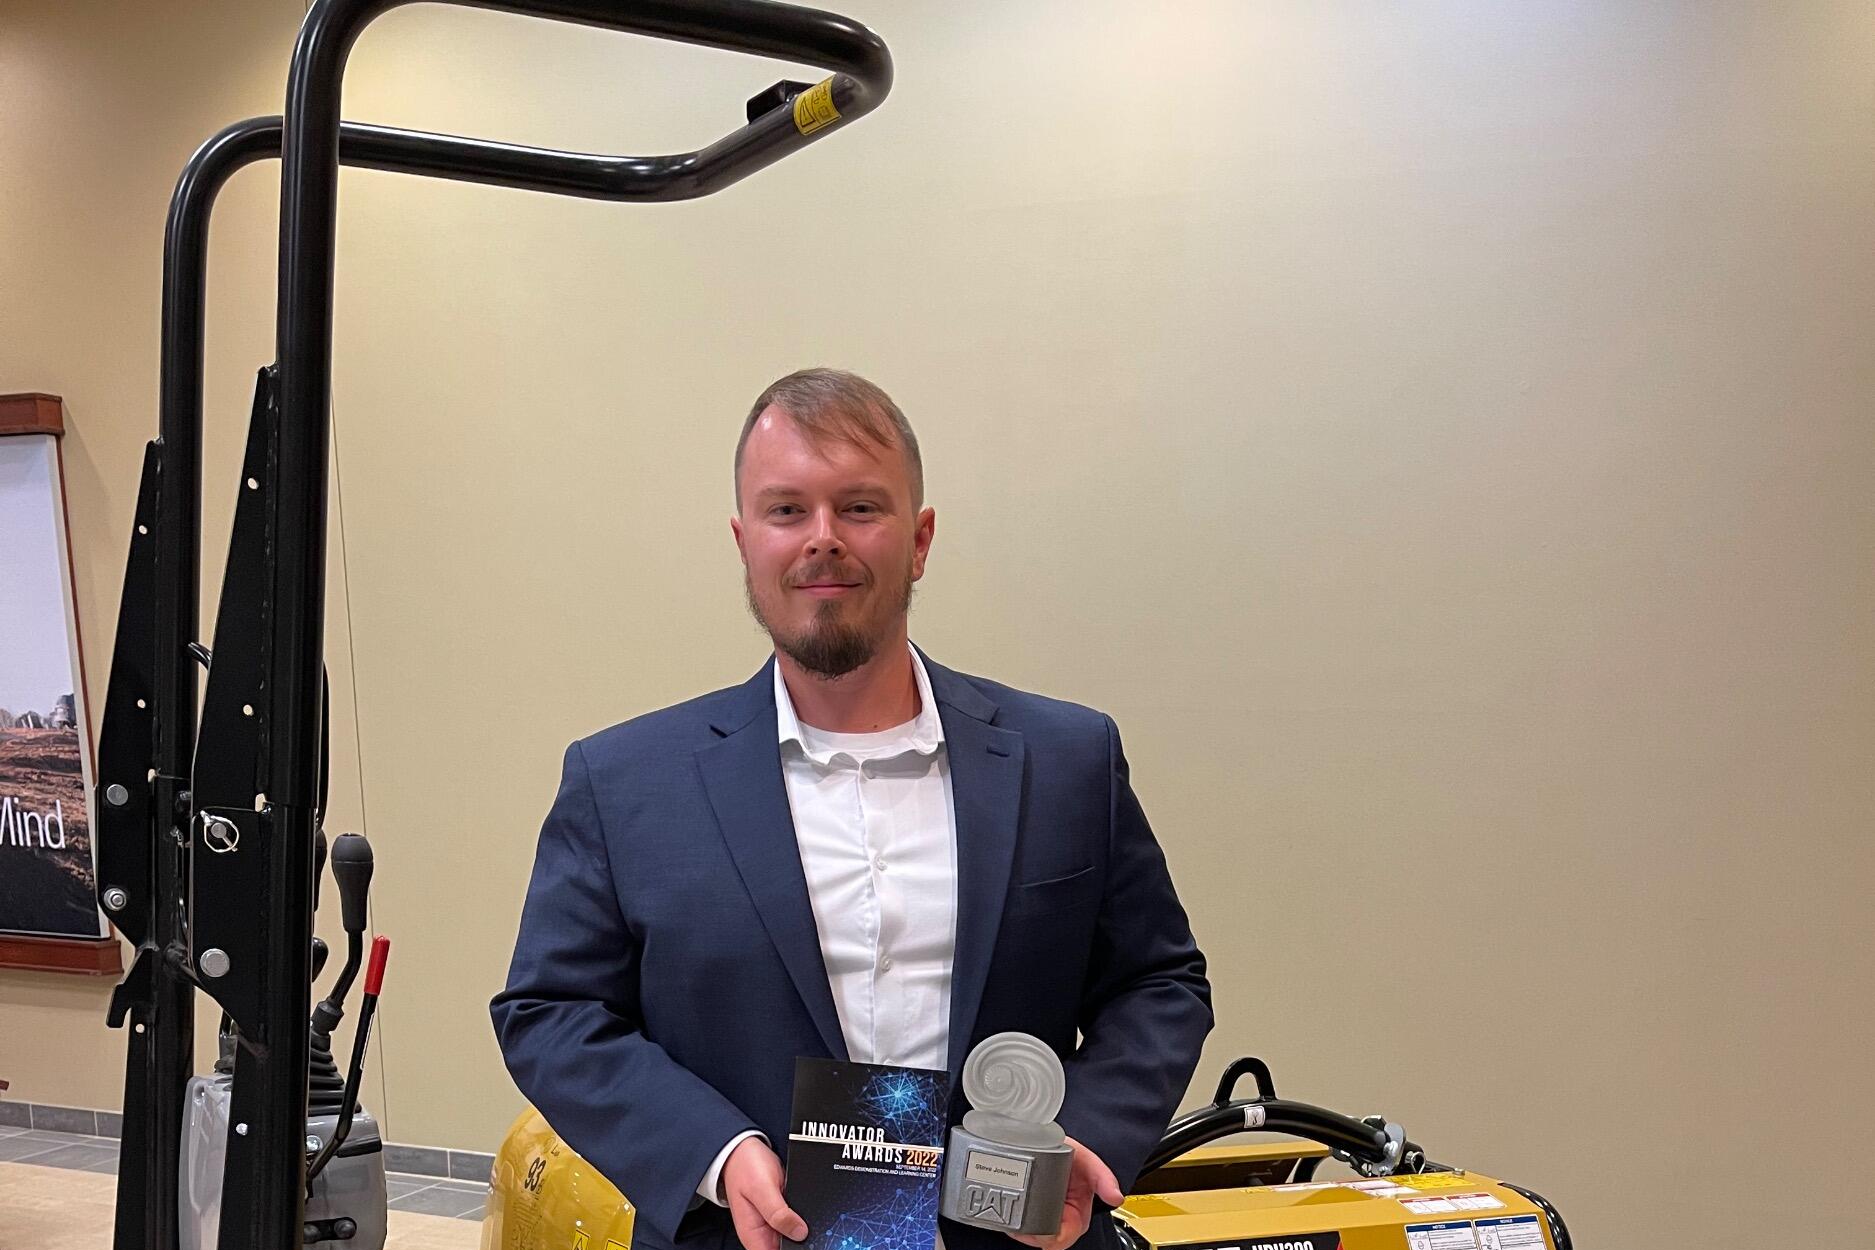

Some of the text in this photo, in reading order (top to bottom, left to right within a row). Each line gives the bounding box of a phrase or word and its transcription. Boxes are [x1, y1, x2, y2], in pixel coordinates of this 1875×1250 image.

[802, 1121, 885, 1143] INNOVATOR
[842, 1143, 938, 1167] AWARDS 2022
[524, 1157, 547, 1191] 93
[975, 1163, 1019, 1177] Steve Johnson
[966, 1185, 1020, 1225] CAT
